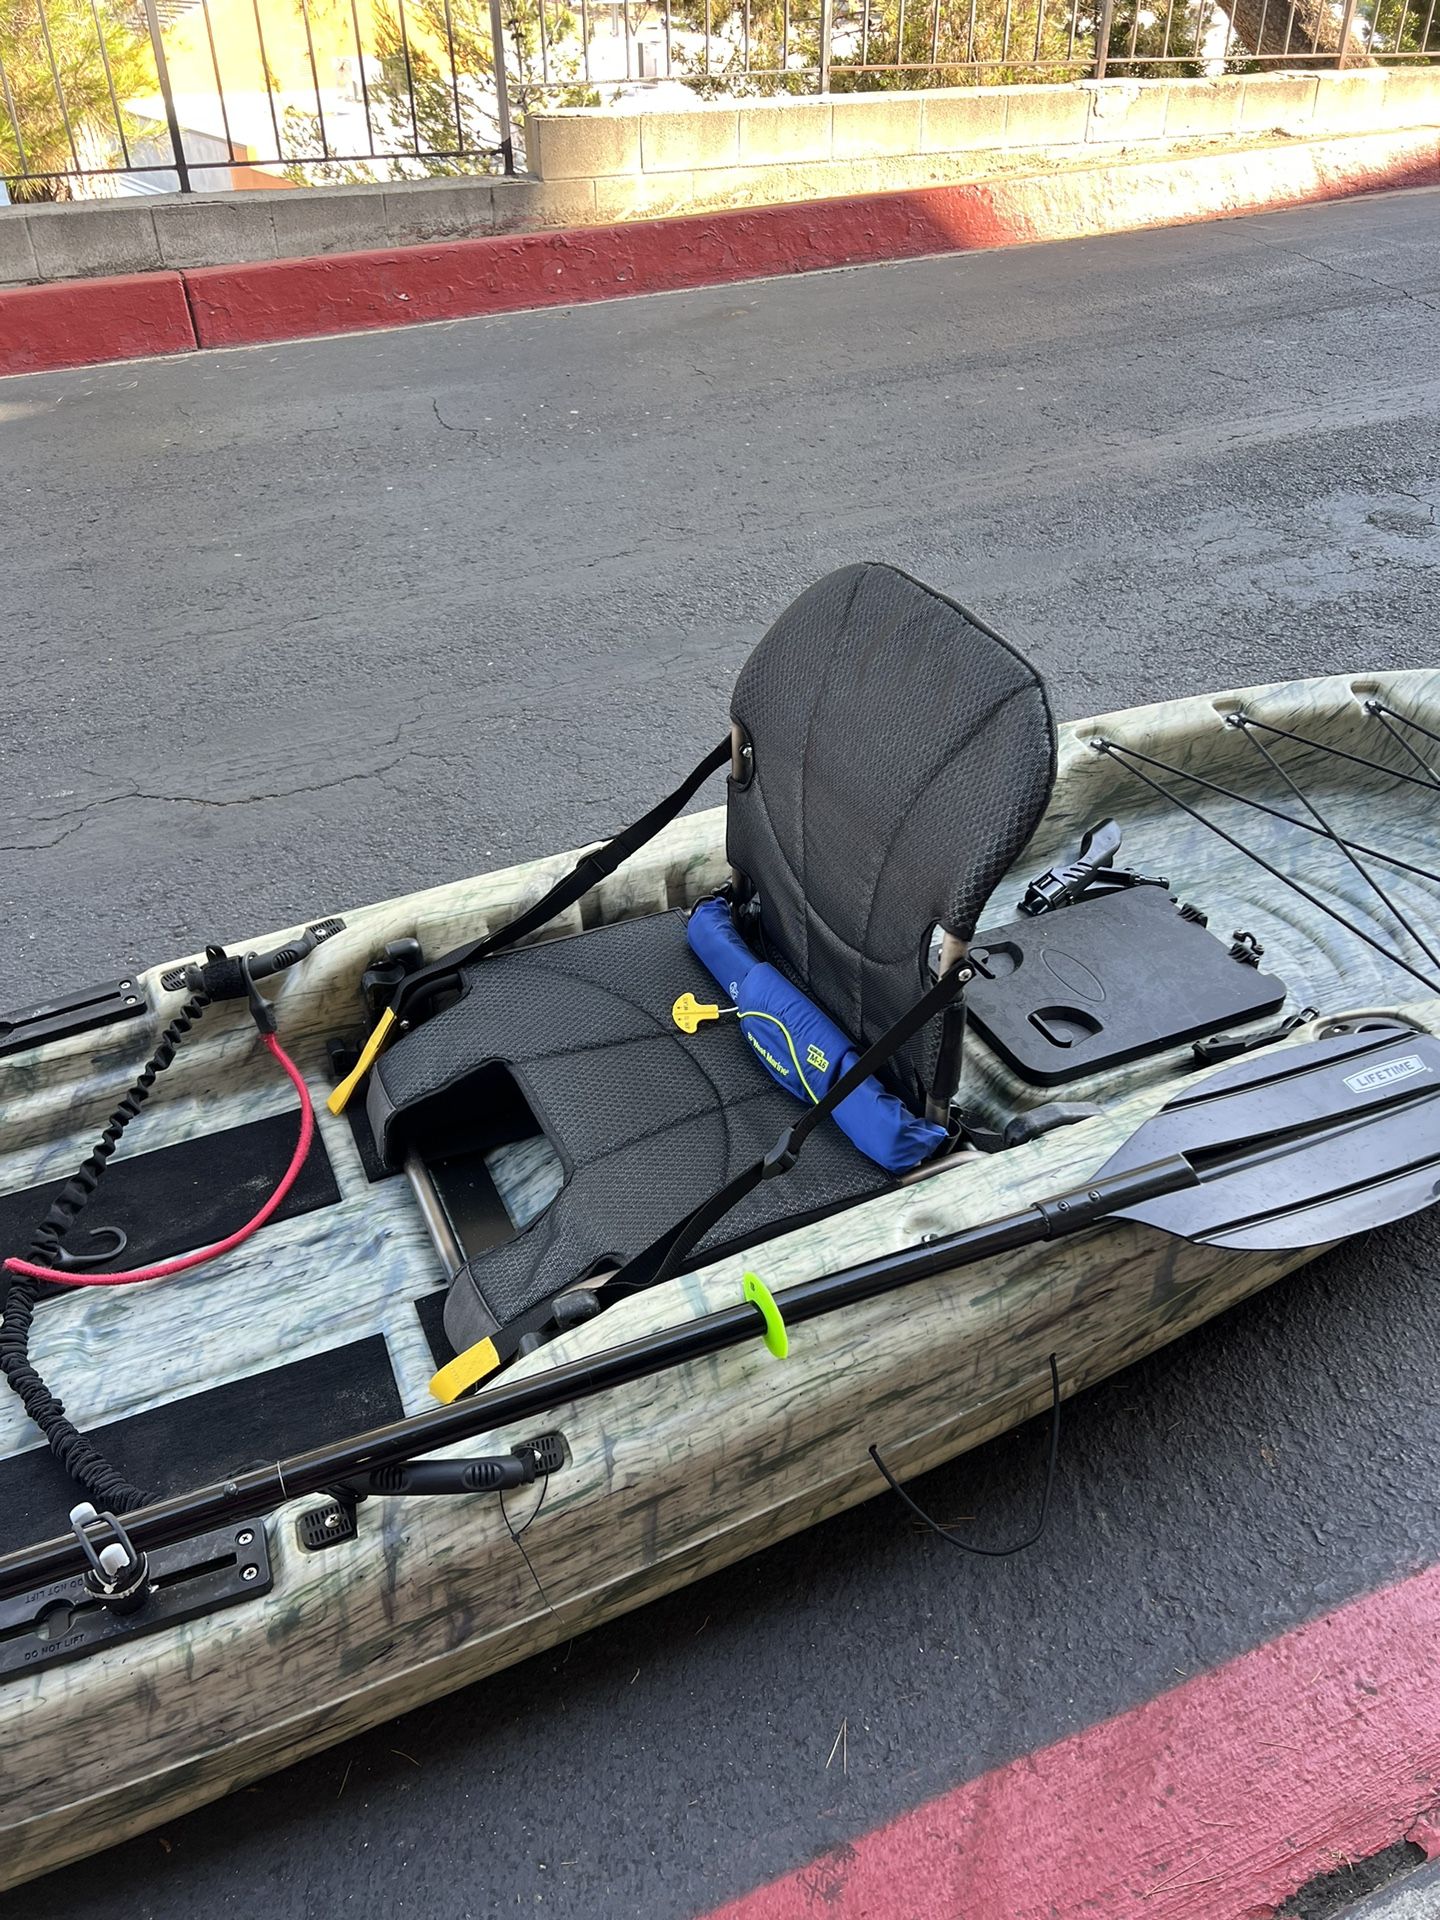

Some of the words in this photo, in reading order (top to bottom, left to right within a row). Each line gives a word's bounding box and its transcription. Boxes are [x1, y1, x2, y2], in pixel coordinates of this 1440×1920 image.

[1356, 1061, 1415, 1087] LIFETIME
[24, 1649, 39, 1661] DO
[41, 1641, 62, 1655] NOT
[64, 1633, 85, 1648] LIFT
